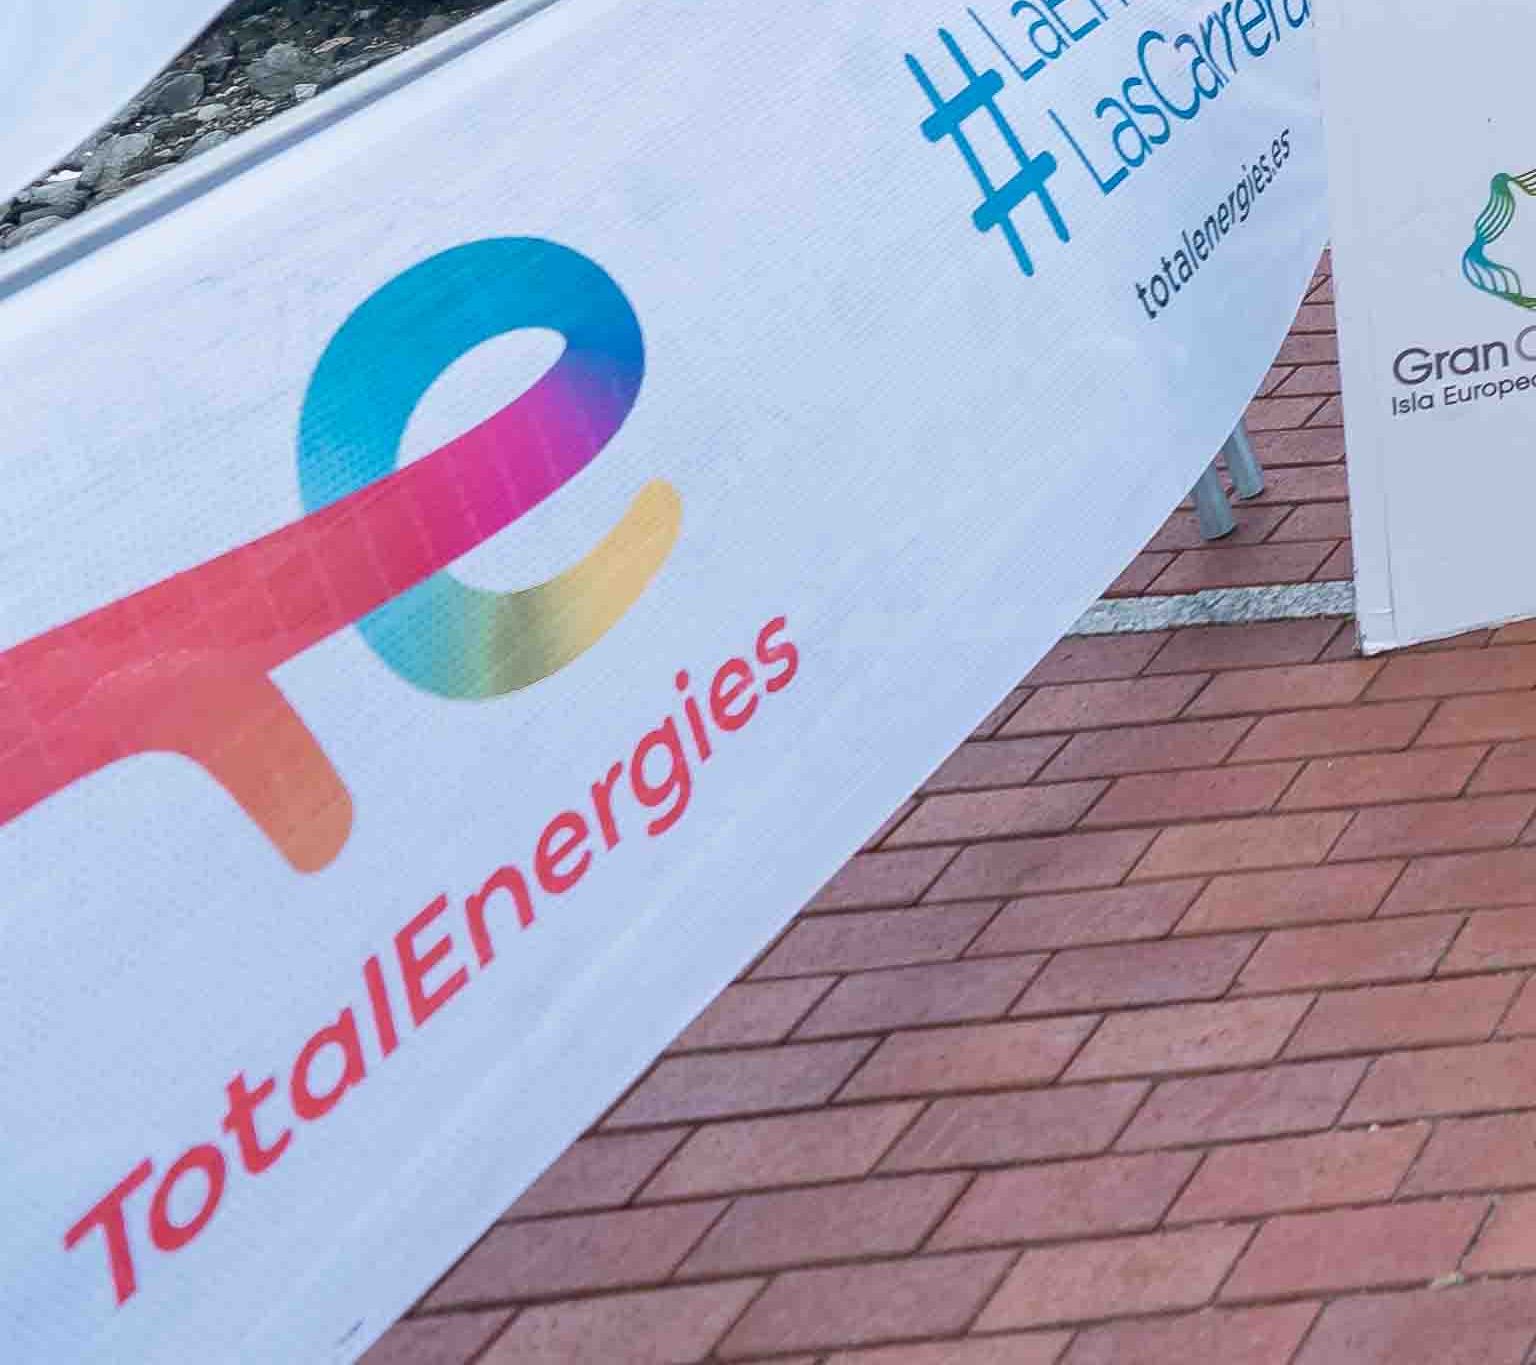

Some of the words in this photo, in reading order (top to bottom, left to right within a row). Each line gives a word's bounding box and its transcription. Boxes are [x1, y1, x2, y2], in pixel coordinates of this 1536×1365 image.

[1136, 125, 1292, 320] totalenergies.es
[1392, 391, 1434, 416] Isla
[1393, 338, 1509, 386] Gran
[64, 615, 801, 1307] TotalEnergies
